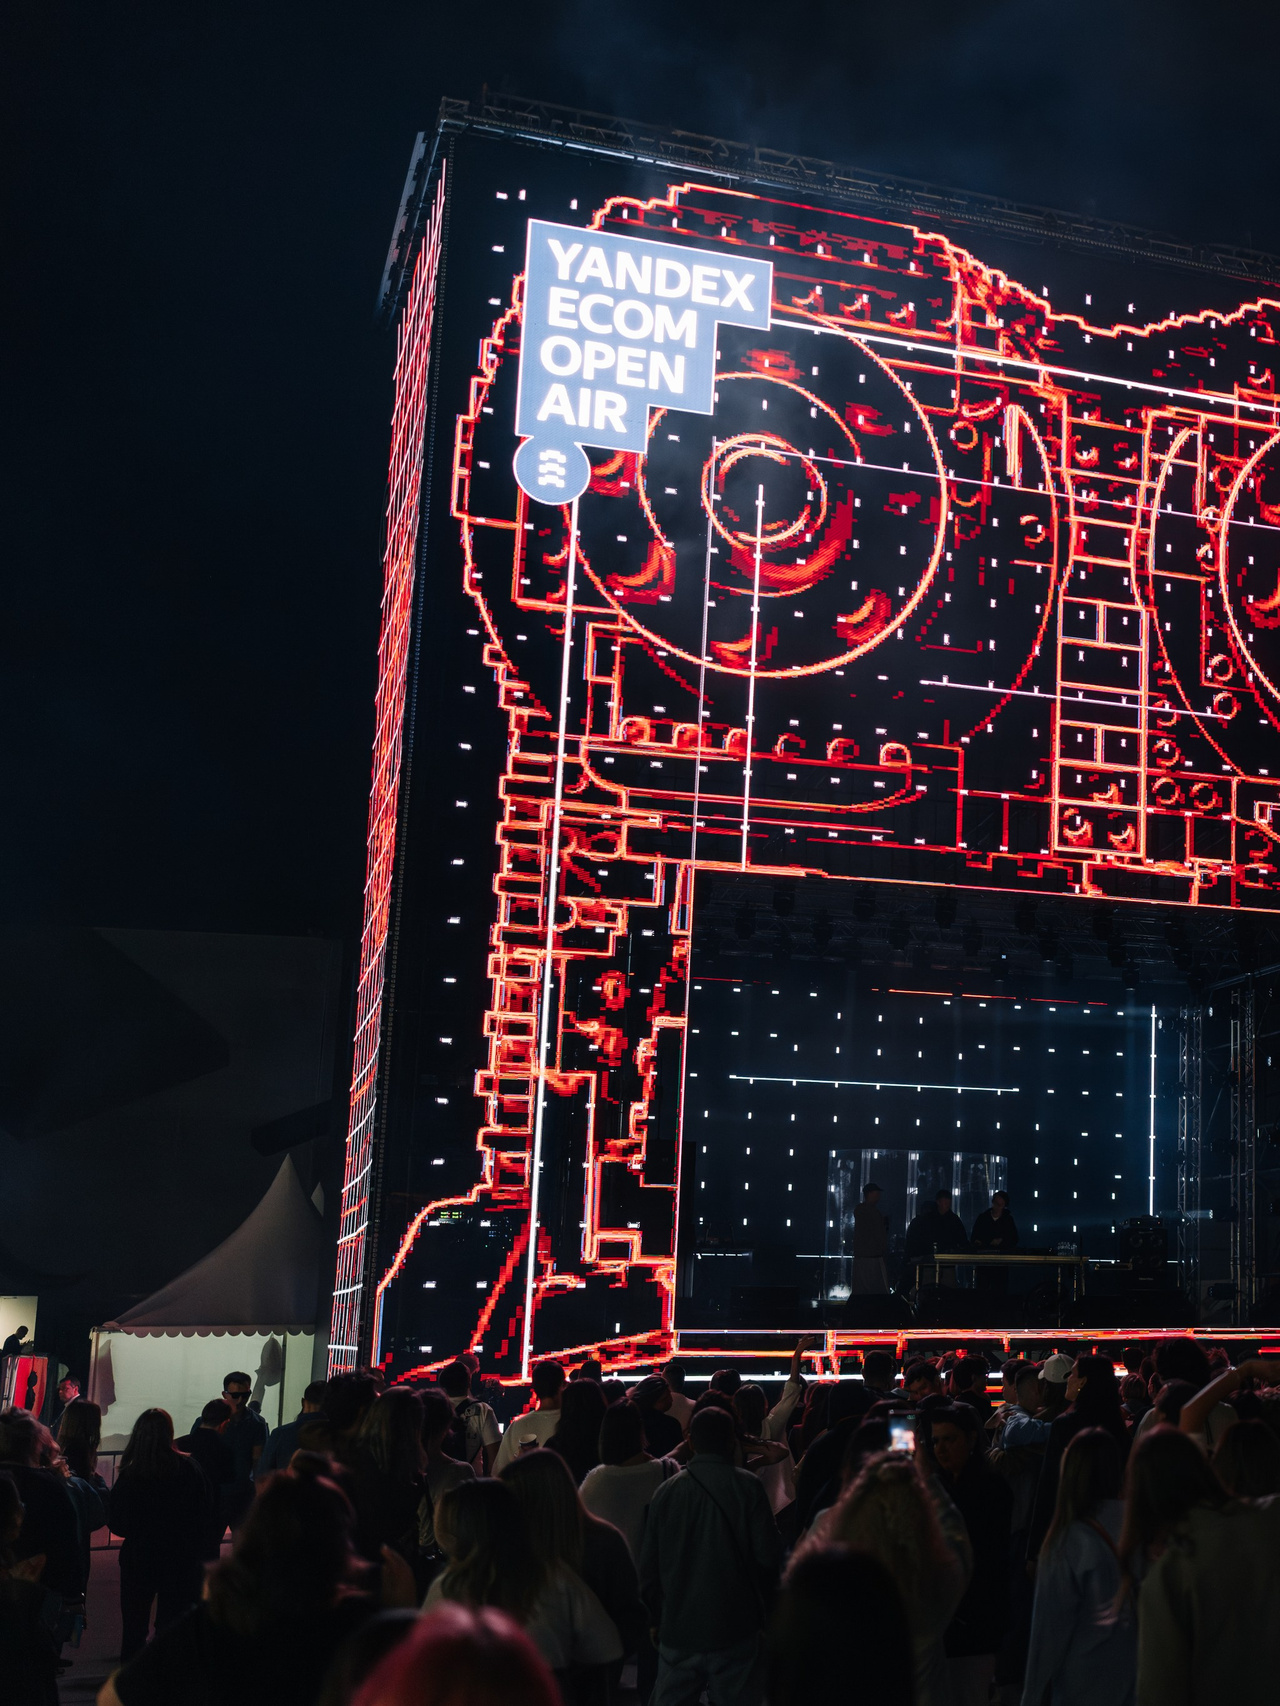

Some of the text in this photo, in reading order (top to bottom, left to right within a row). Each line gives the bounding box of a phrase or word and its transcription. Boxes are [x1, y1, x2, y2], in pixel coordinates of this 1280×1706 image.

[547, 238, 755, 312] YANDEX
[548, 286, 697, 348] ECOM
[540, 335, 685, 394] OPEN
[536, 383, 628, 433] AIR
